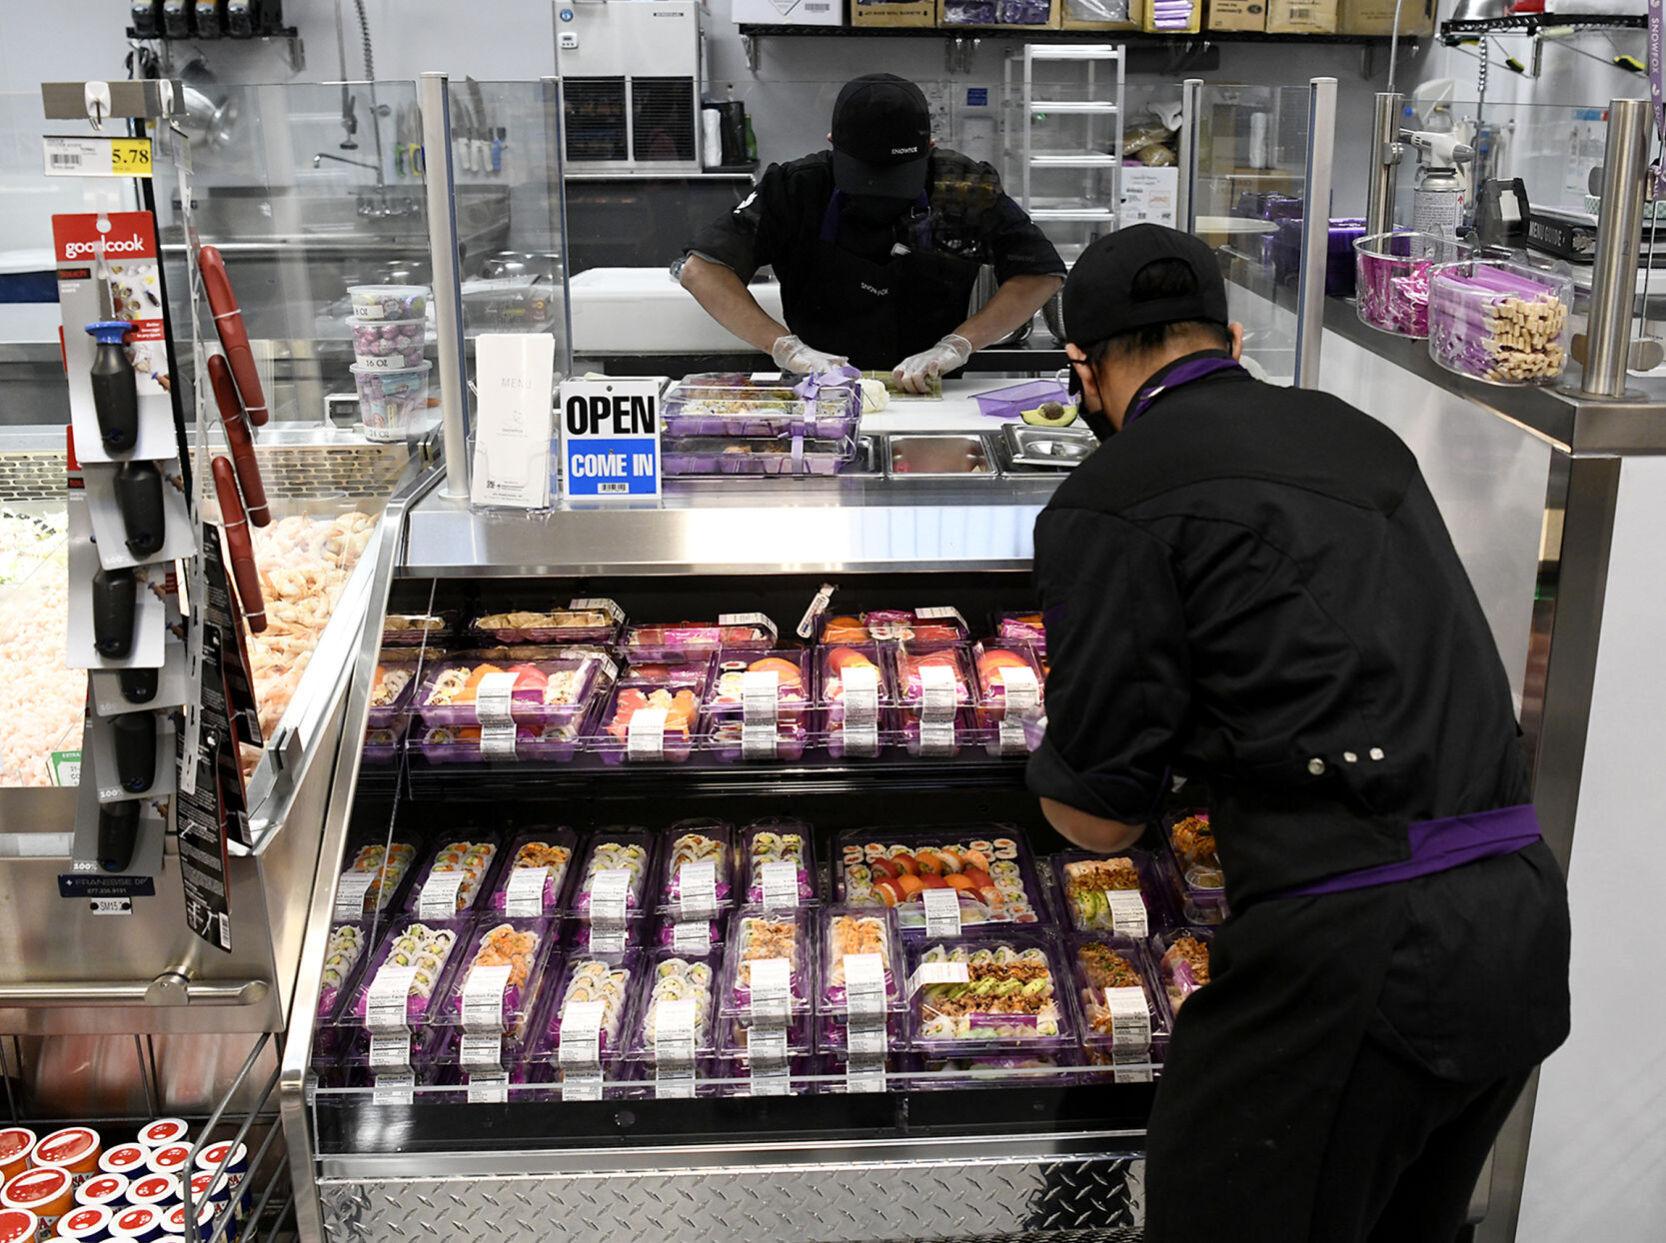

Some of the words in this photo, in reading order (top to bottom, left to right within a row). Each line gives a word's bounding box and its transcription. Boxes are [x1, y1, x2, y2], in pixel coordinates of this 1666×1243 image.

[1651, 17, 1659, 73] SNOWFOX
[112, 149, 149, 164] 5.78
[500, 377, 532, 390] MENU
[566, 395, 655, 435] OPEN
[571, 454, 627, 477] COME
[633, 454, 653, 476] IN
[73, 862, 98, 870] 100%
